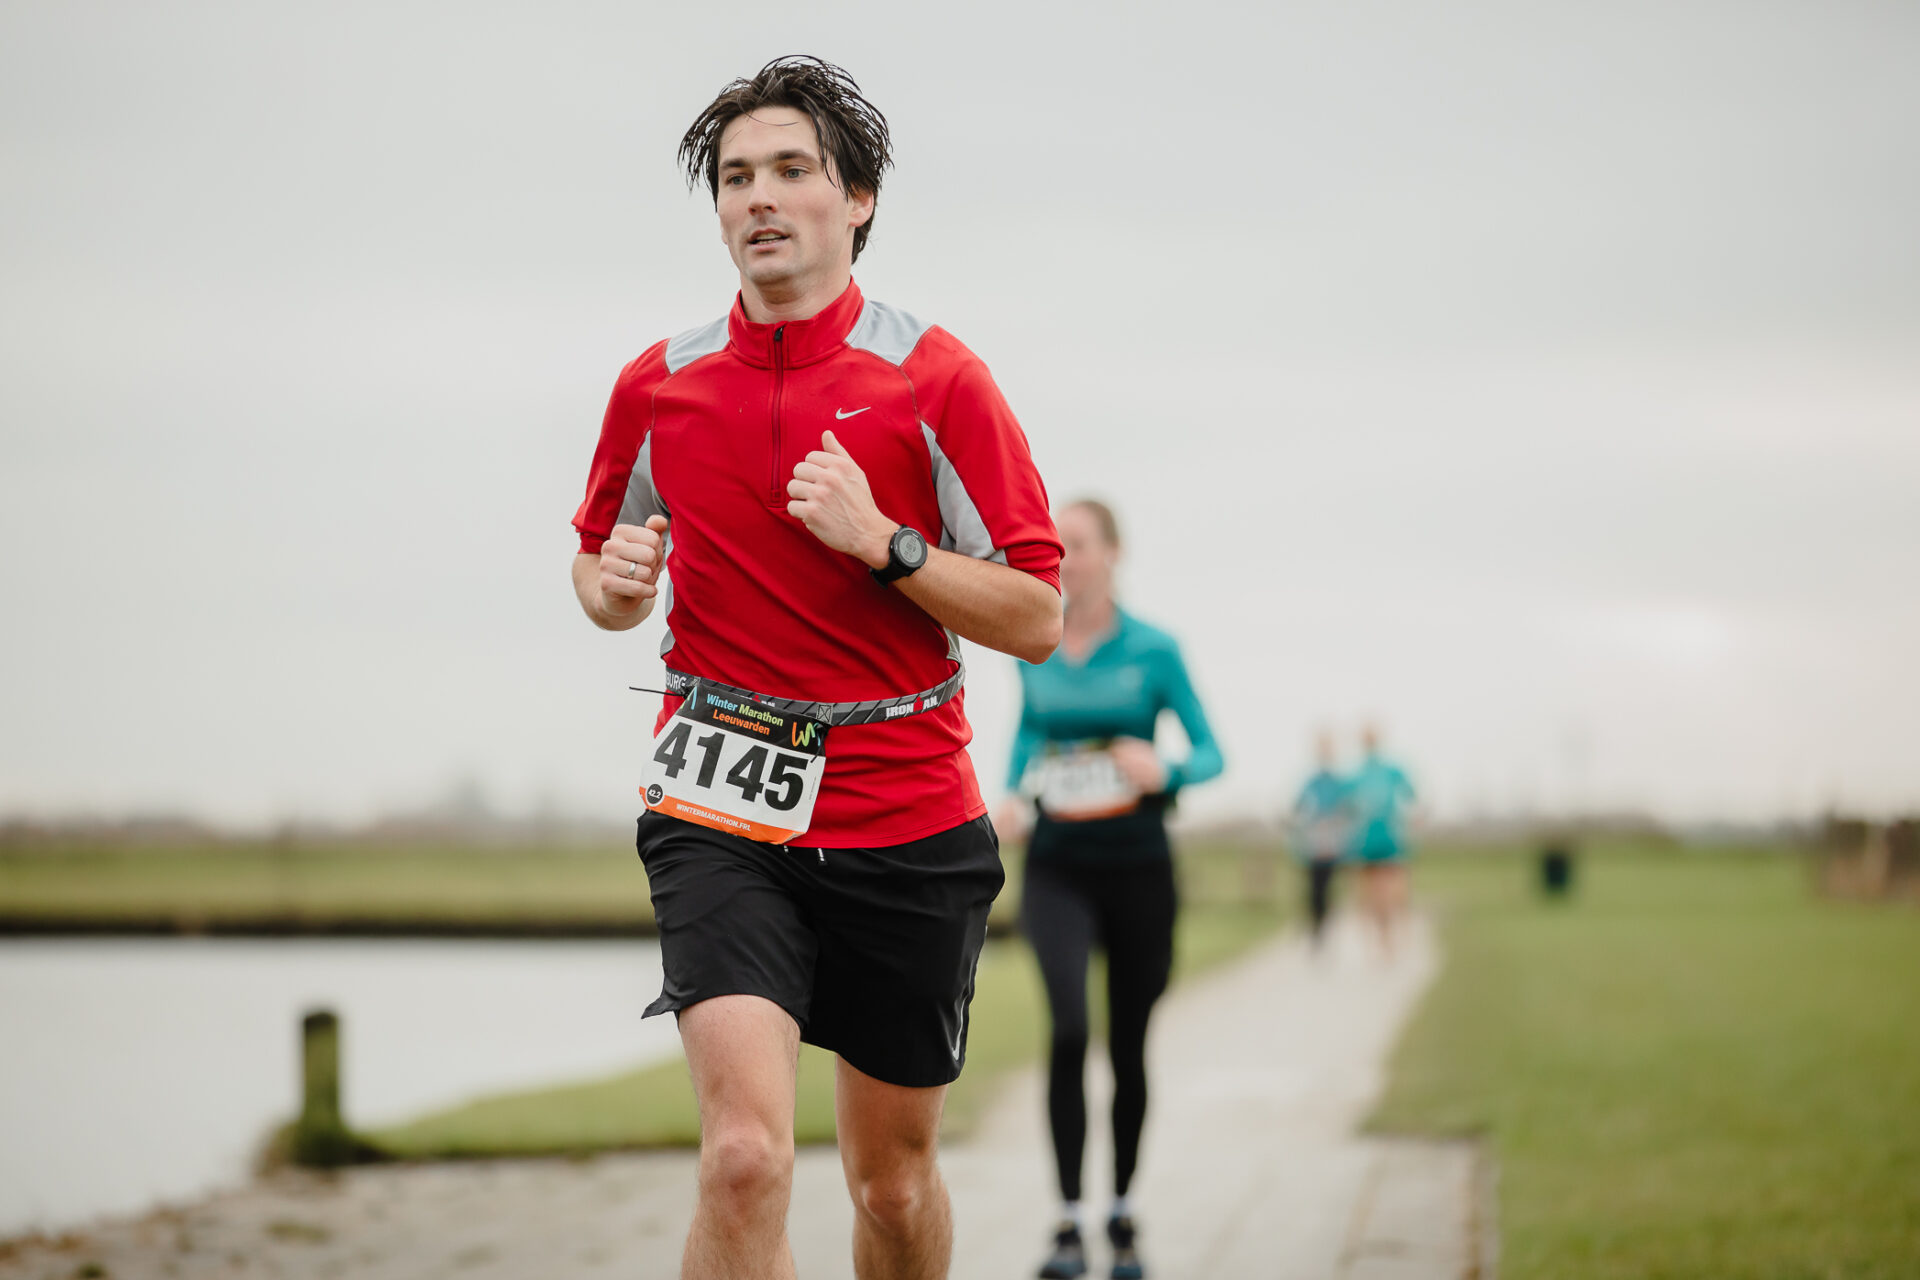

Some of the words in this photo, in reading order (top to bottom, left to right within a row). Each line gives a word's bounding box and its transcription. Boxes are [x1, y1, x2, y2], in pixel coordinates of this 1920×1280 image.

[706, 693, 738, 712] Winter
[738, 703, 784, 727] Marathon
[712, 709, 770, 736] Leeuwarden
[653, 721, 805, 812] 4145
[676, 803, 752, 831] WINTERMARATHON.FRL
